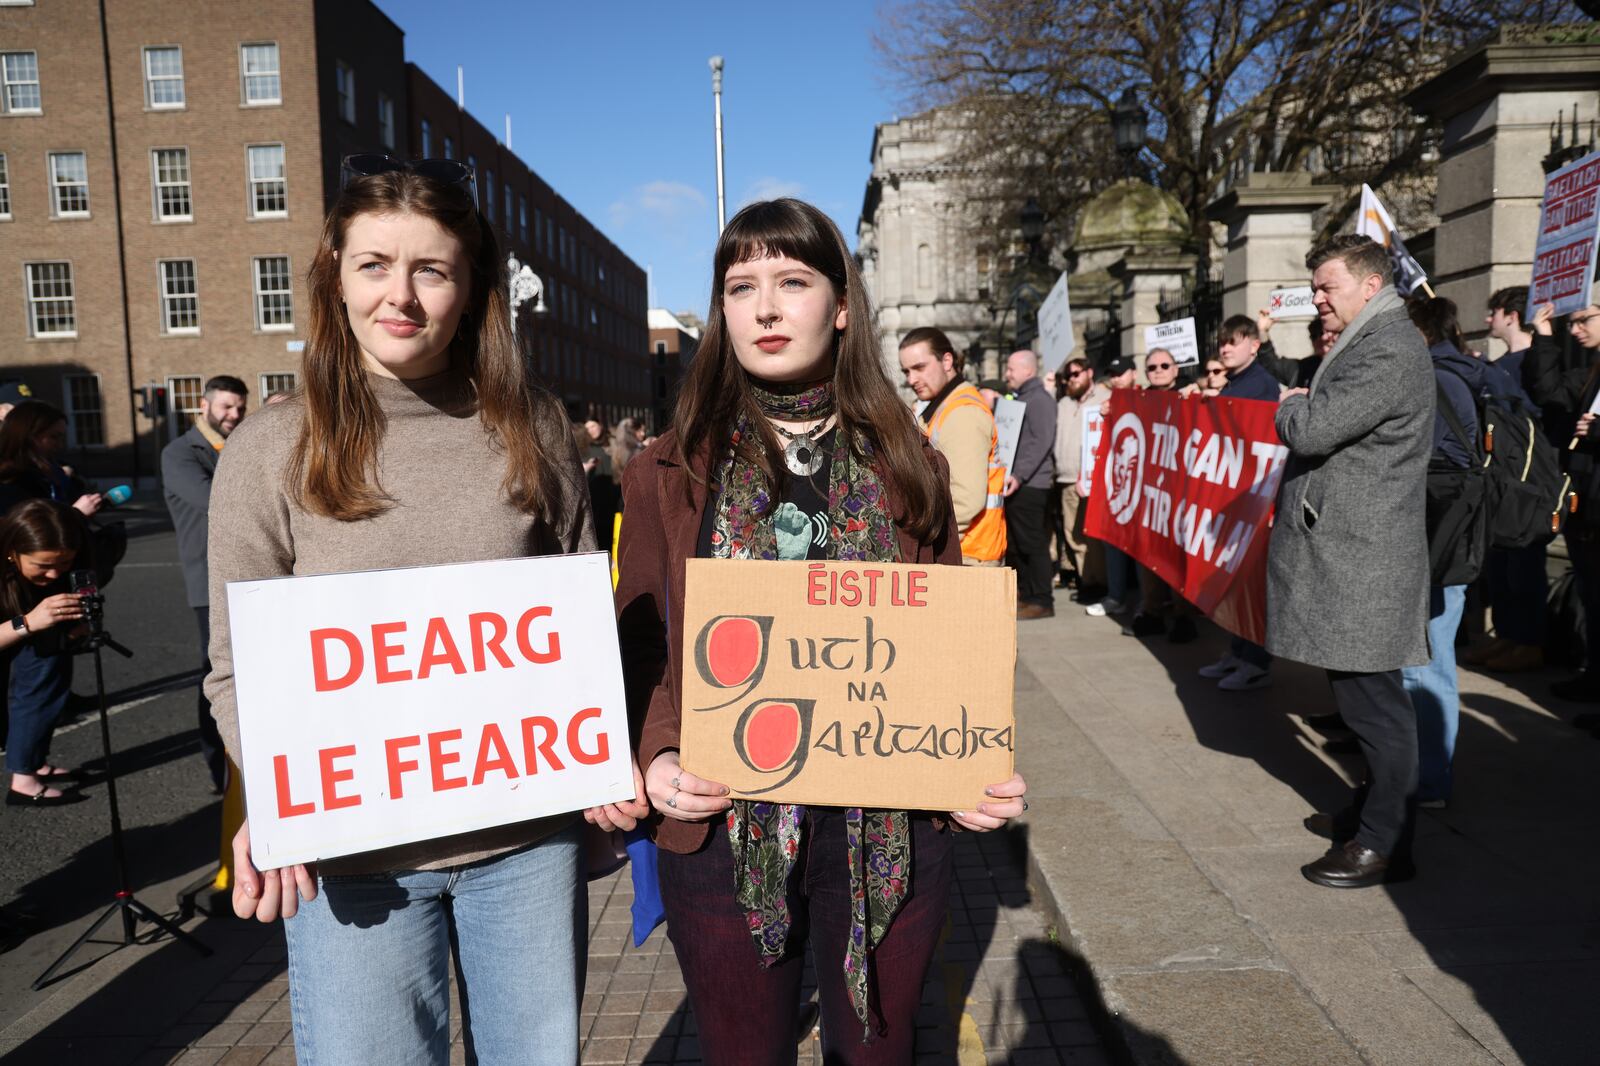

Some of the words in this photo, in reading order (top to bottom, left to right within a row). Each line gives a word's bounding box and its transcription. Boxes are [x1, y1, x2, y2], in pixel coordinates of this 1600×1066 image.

[1547, 163, 1600, 202] GAELTACH
[1151, 405, 1179, 472] TÍR
[1183, 428, 1244, 489] GAN
[1142, 472, 1172, 538] TÍR
[891, 570, 928, 607] LE
[309, 605, 562, 692] DEARG
[847, 681, 888, 702] NA
[273, 744, 362, 819] LE
[384, 707, 611, 800] FEARG
